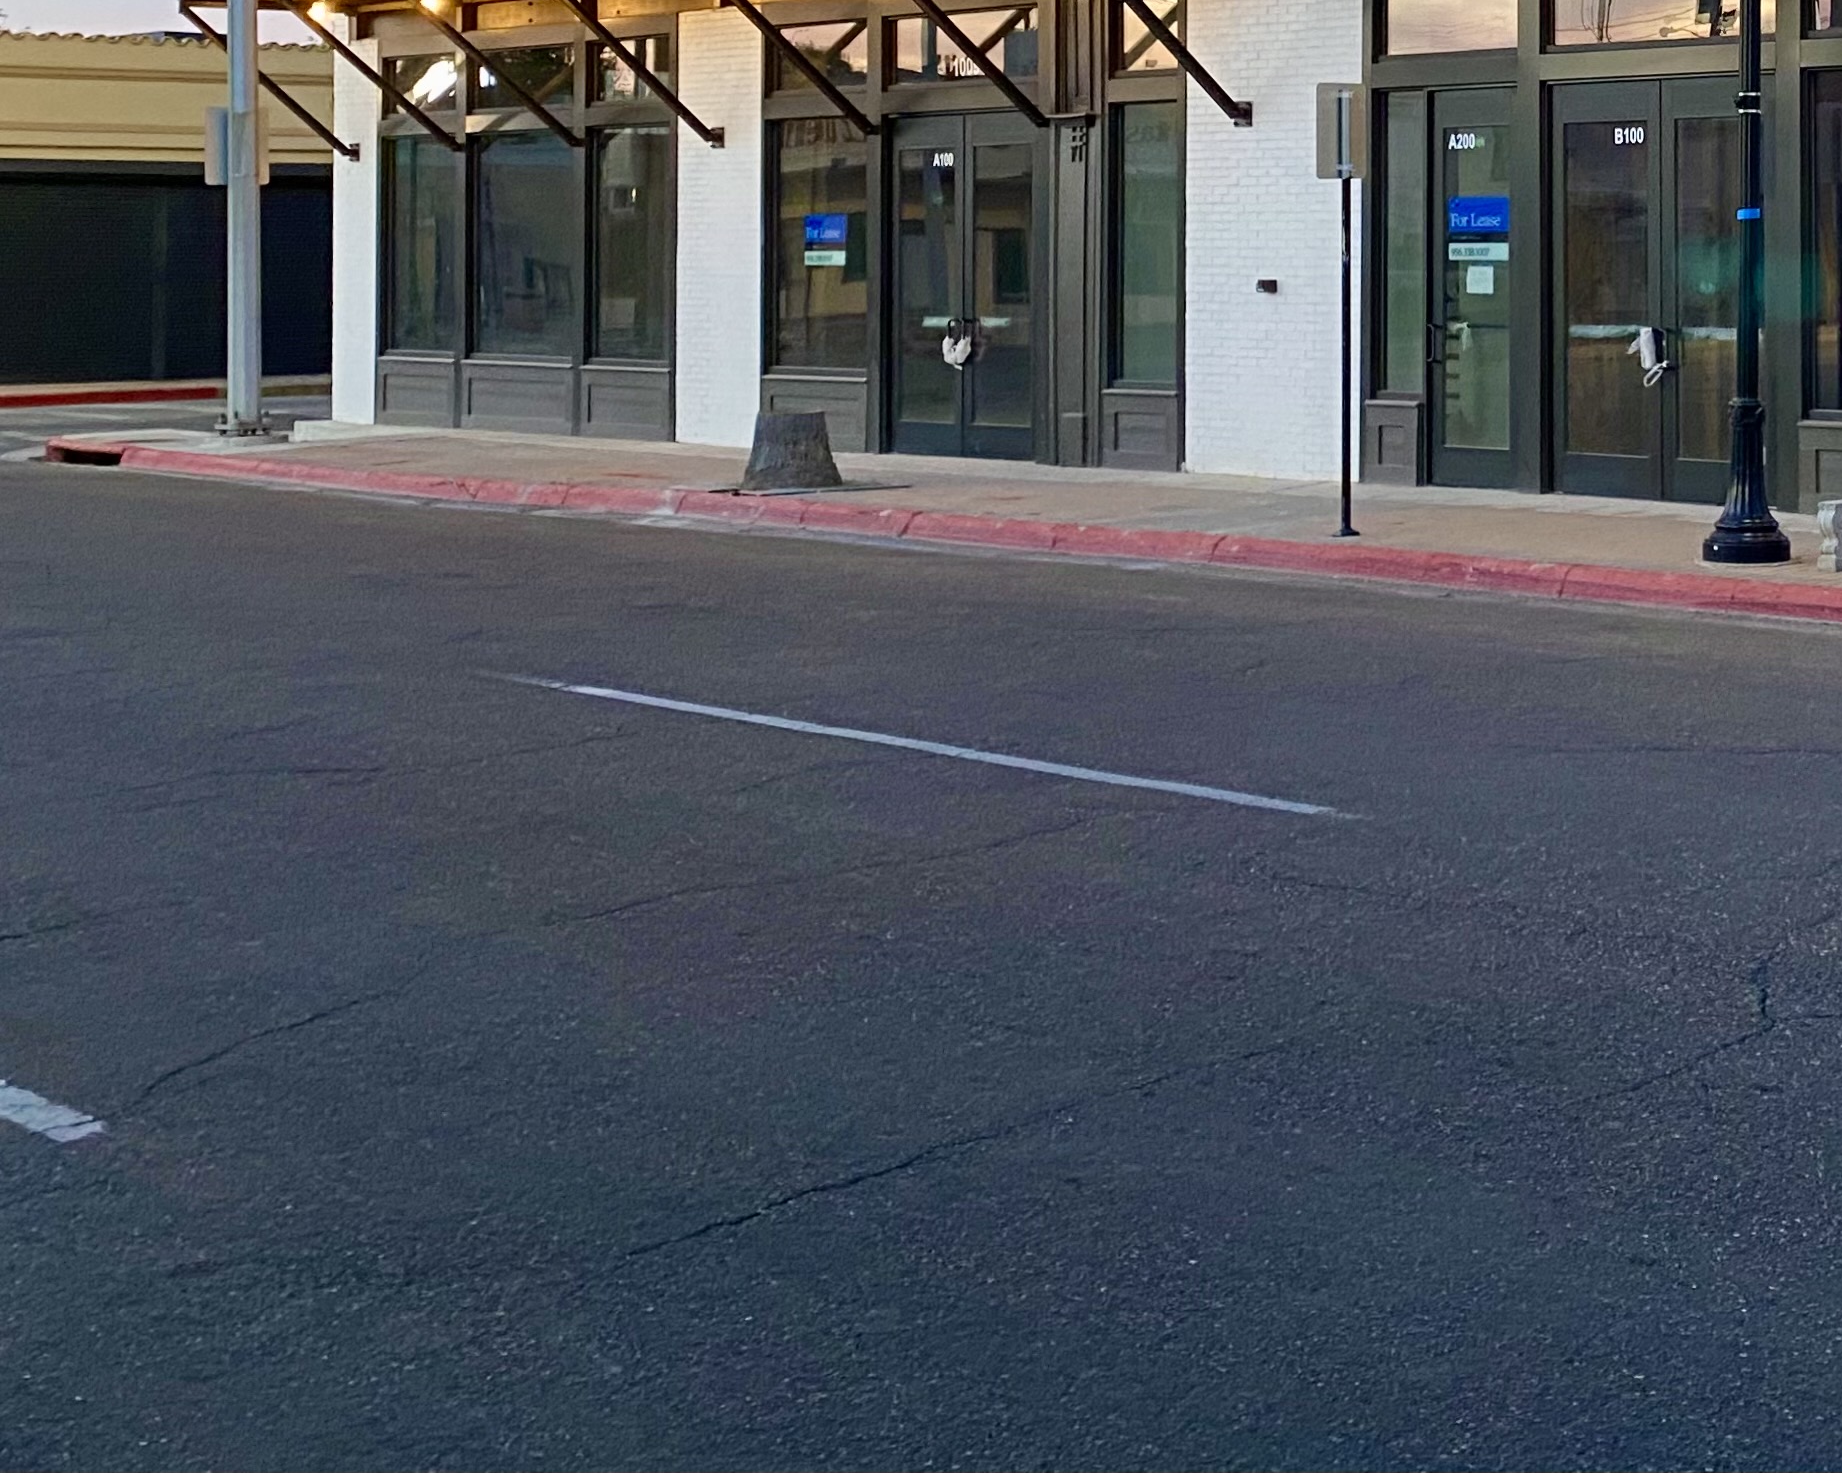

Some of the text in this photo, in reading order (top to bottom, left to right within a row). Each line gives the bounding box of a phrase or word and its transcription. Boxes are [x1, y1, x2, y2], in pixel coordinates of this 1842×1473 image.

[1448, 133, 1476, 150] A200
[1614, 126, 1645, 145] B100
[932, 152, 954, 167] A100
[1450, 213, 1501, 227] For Lease
